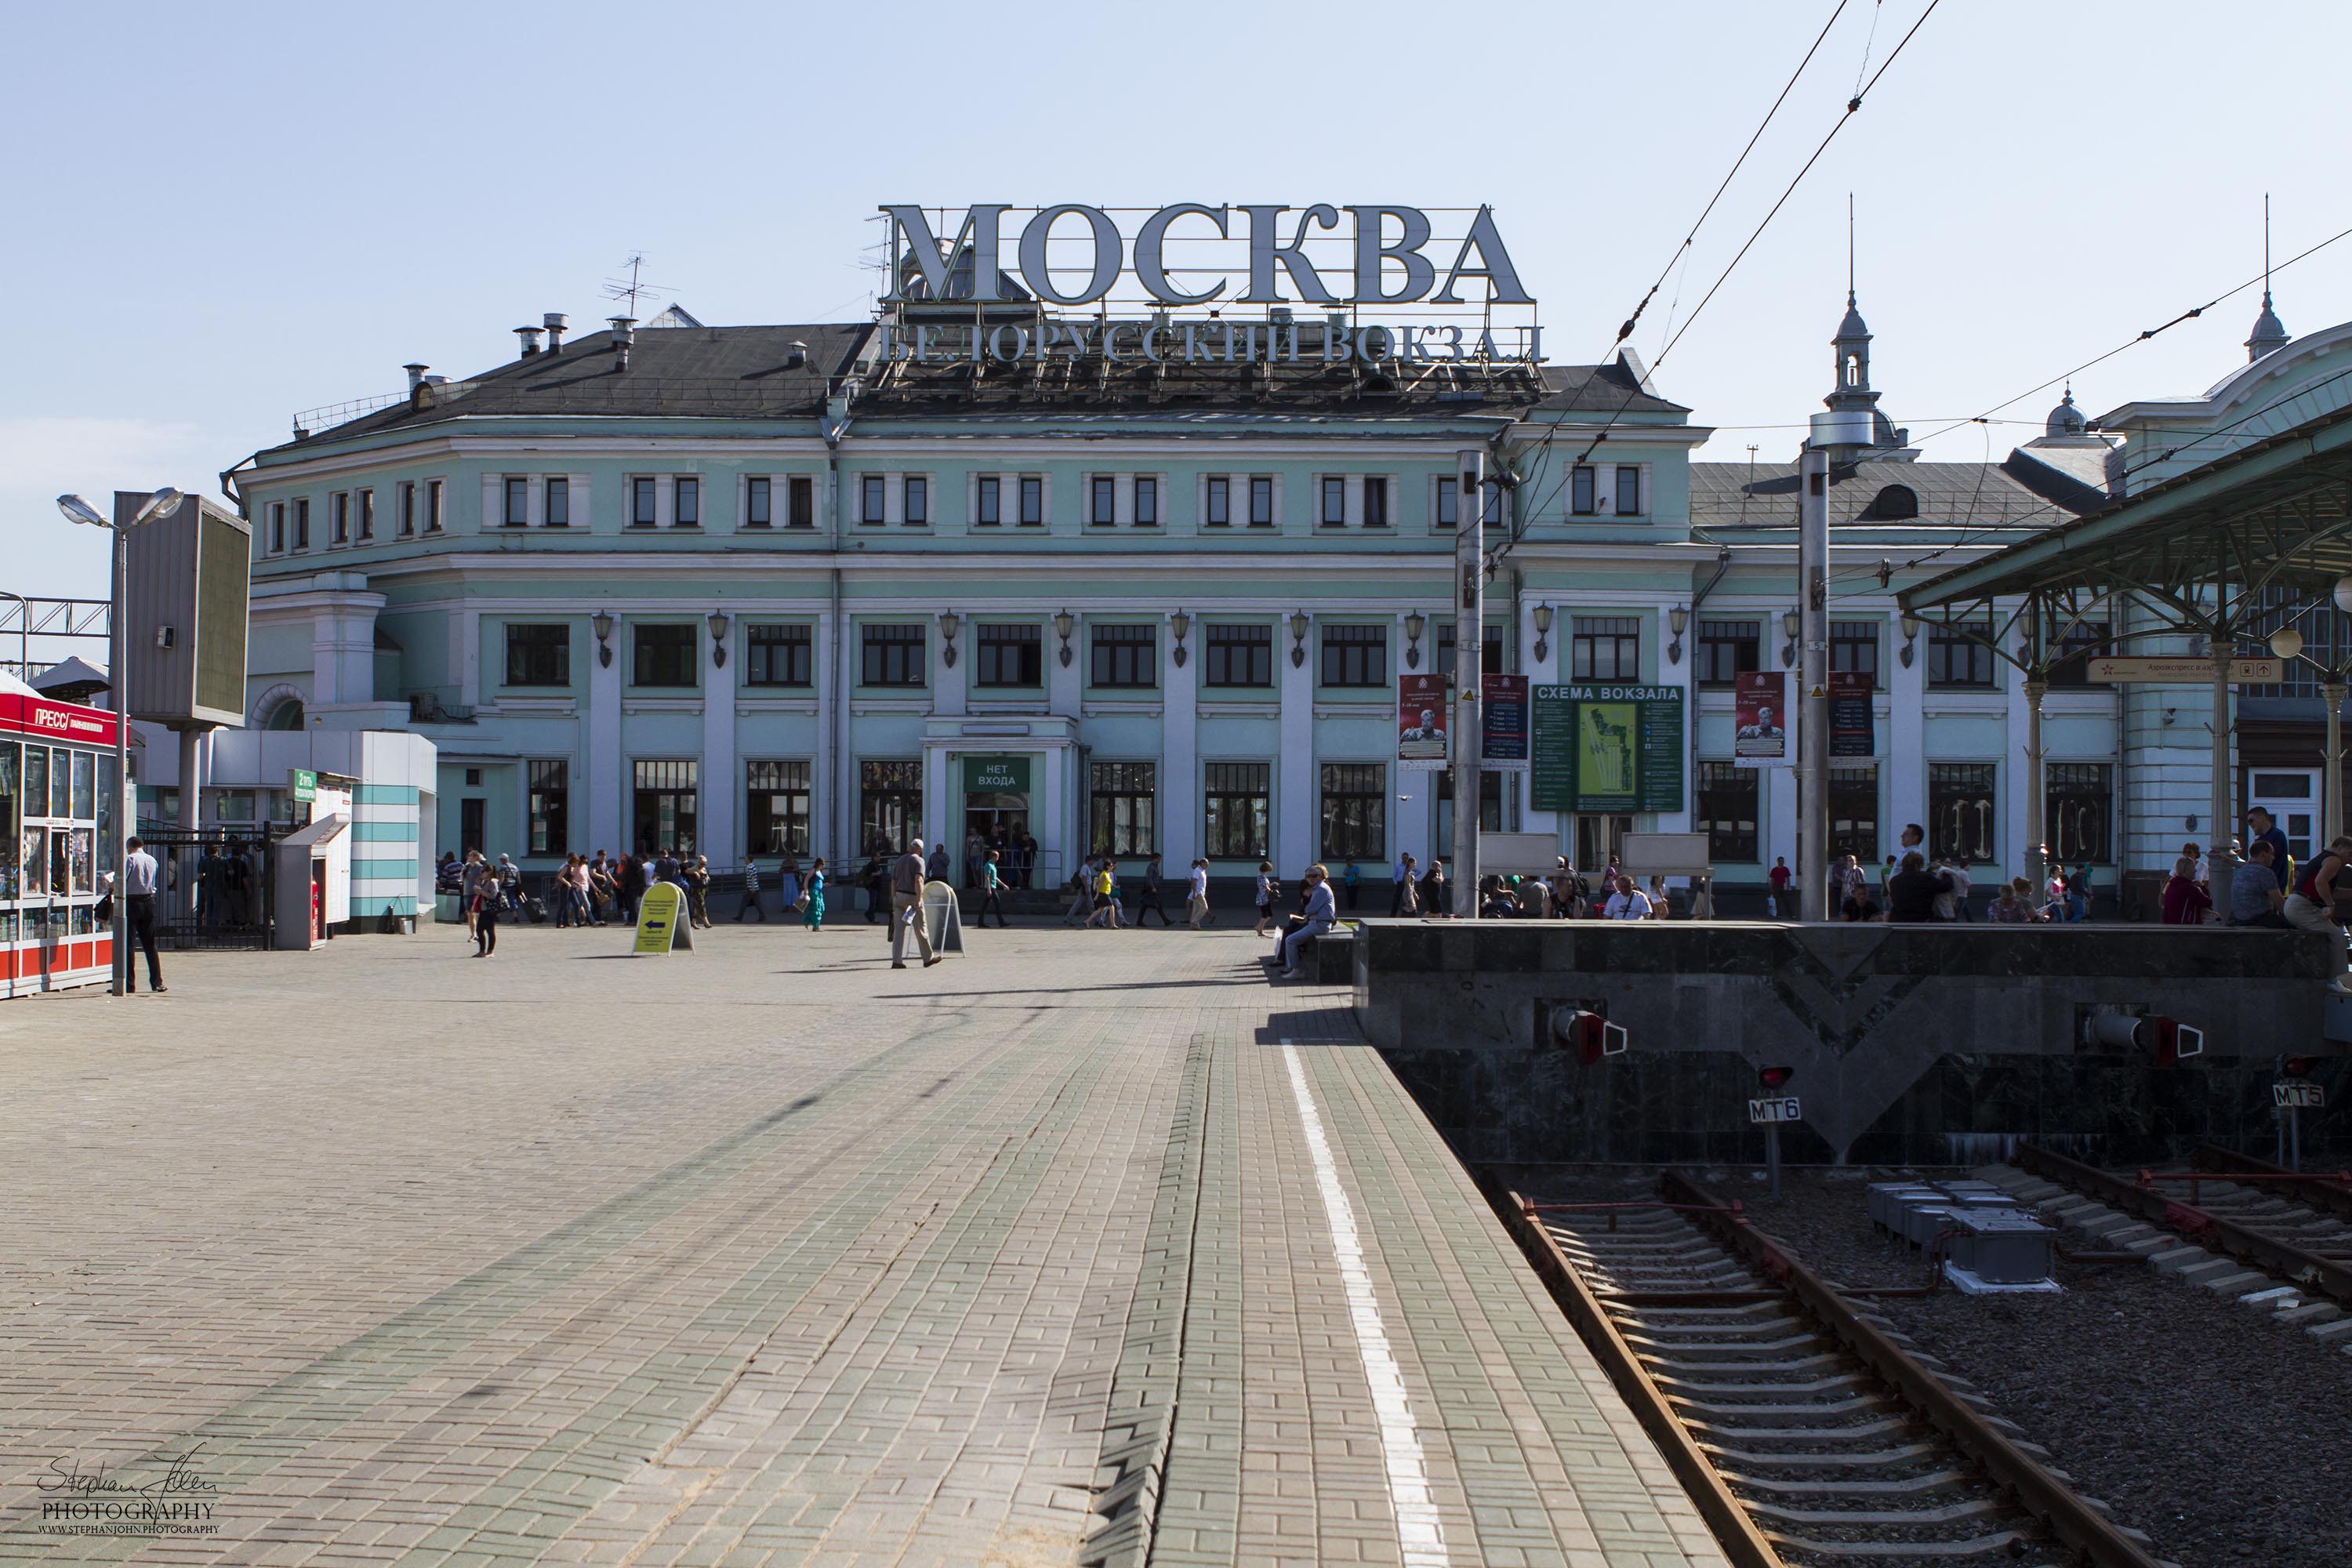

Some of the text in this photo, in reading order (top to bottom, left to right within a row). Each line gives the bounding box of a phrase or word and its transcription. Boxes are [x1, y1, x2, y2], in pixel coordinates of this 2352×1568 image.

[878, 203, 1537, 305] МОСКВА
[877, 316, 1544, 363] БЕЛОРУССКИЙ ВОКЗАЛ
[1537, 687, 1679, 700] СХЕМА ВОКЗАЛА
[35, 708, 66, 728] ПРЕСС
[986, 765, 1008, 774] НЕТ
[978, 776, 1016, 786] ВХОДА
